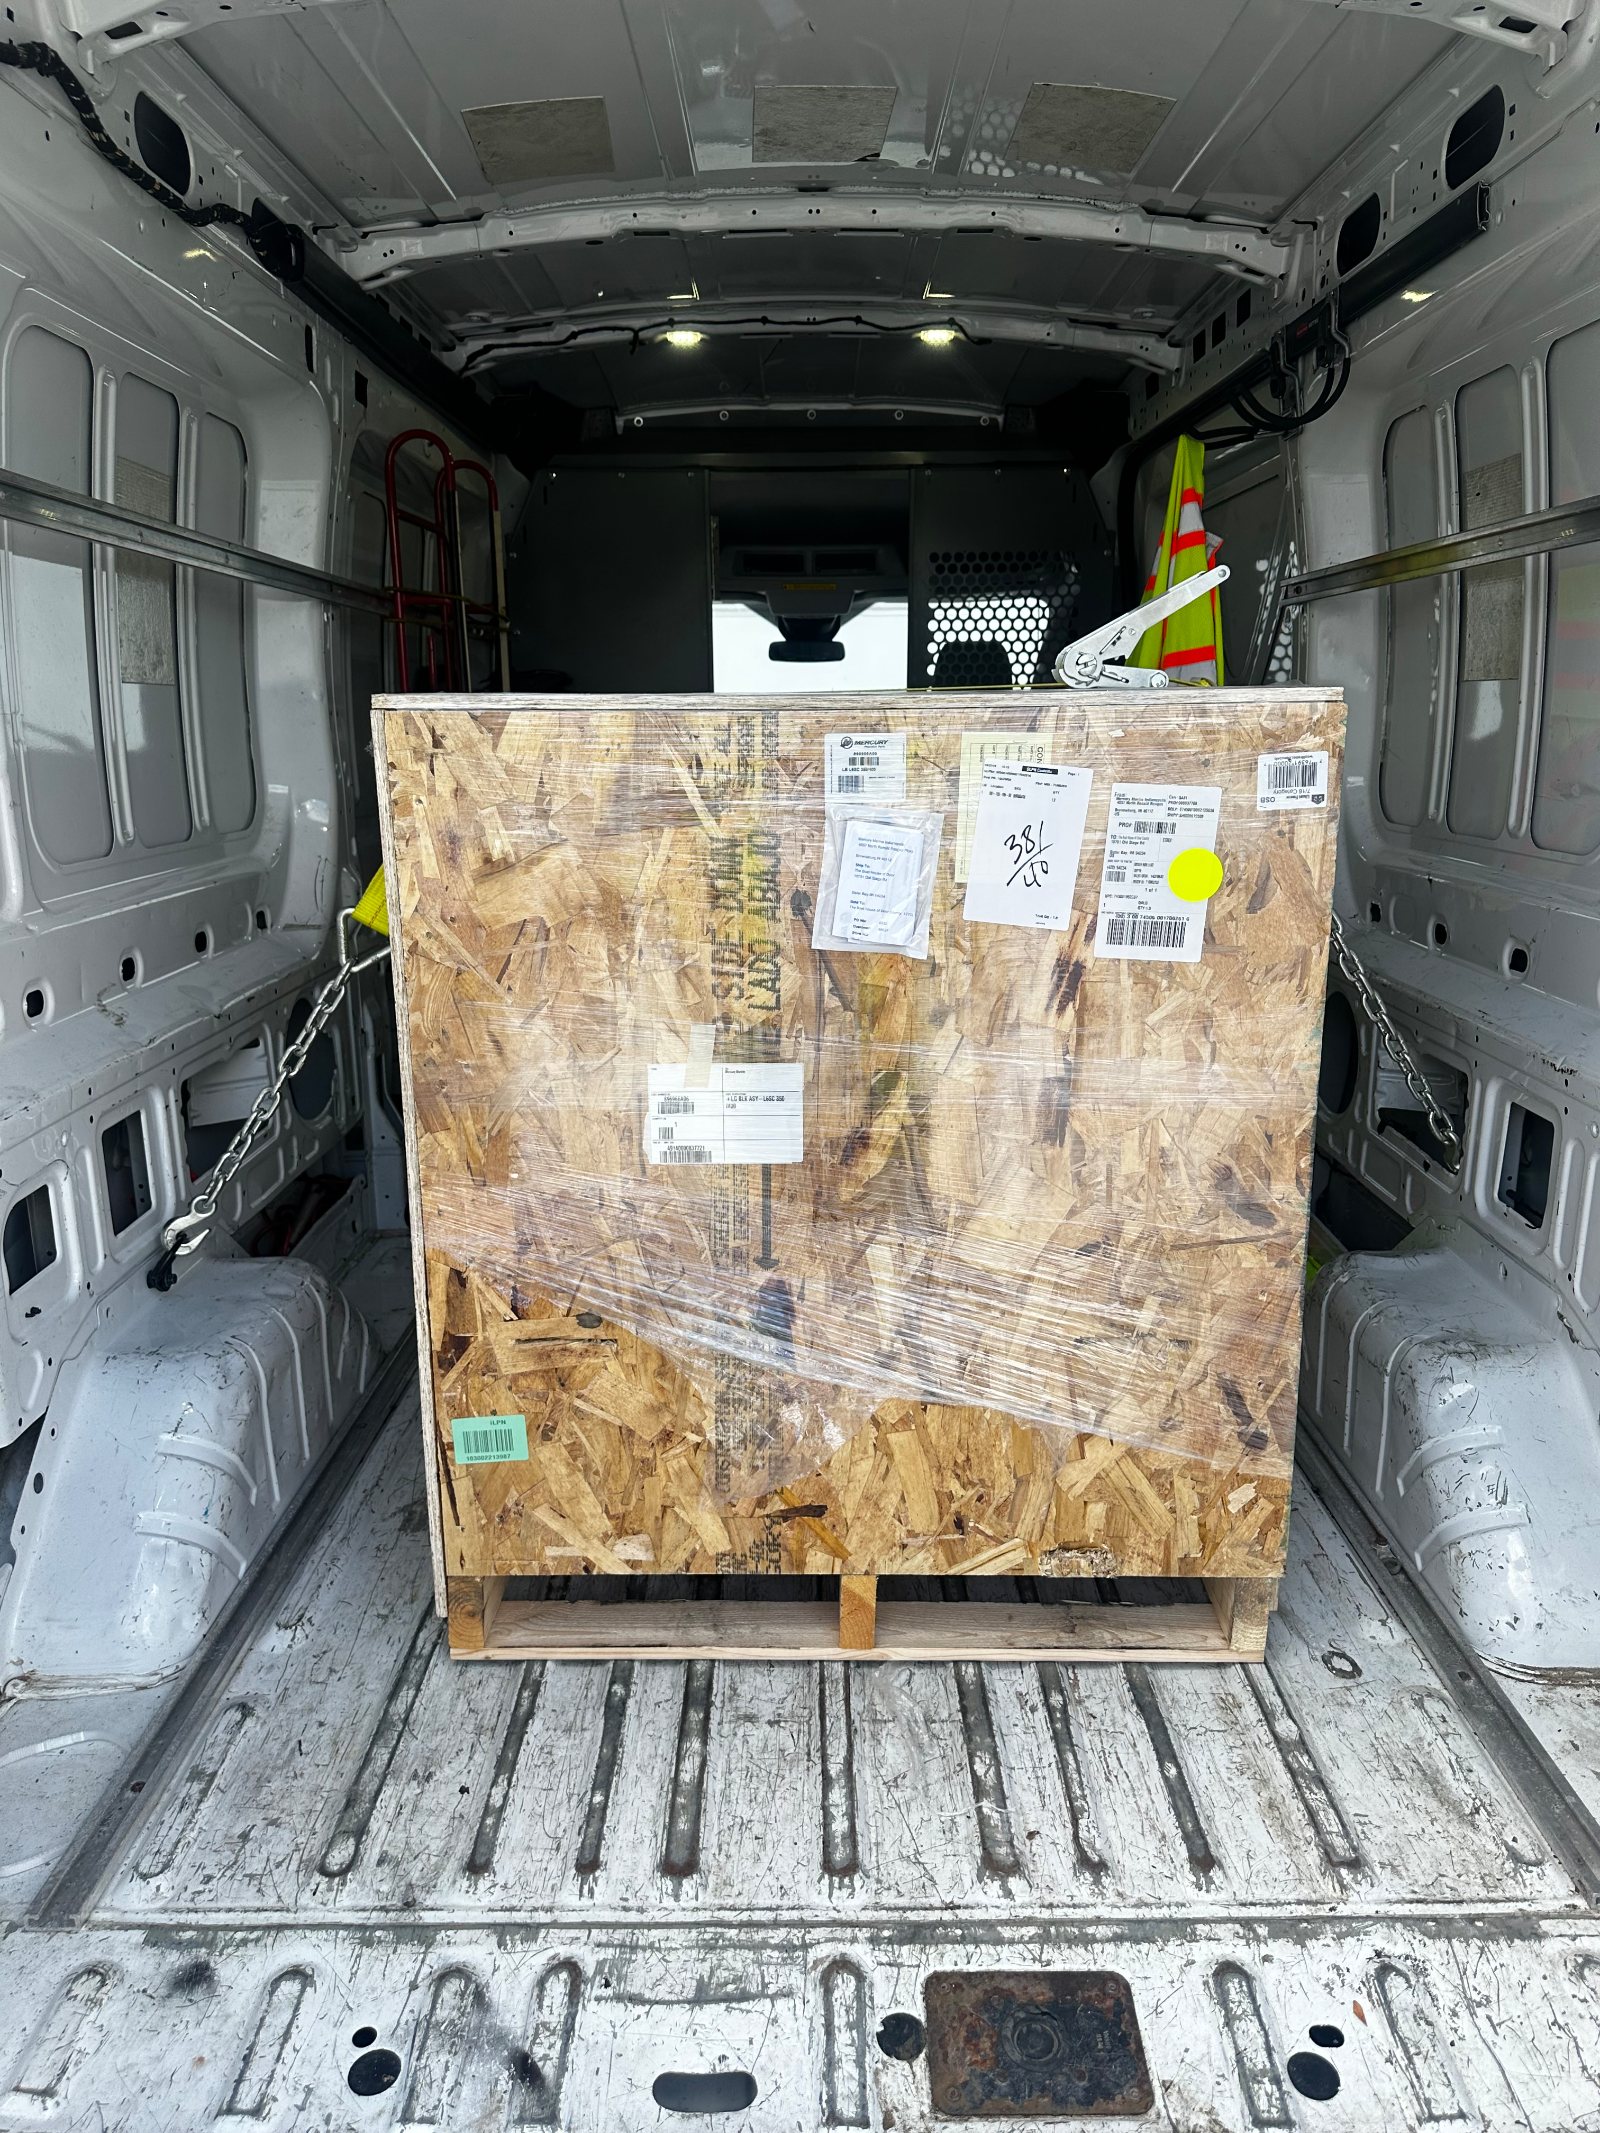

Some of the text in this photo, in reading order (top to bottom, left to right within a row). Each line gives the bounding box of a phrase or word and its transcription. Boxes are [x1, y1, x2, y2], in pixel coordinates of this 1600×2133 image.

[710, 836, 744, 1000] SIDE DOWN
[748, 830, 782, 924] ABAJO
[748, 937, 781, 1010] LADO
